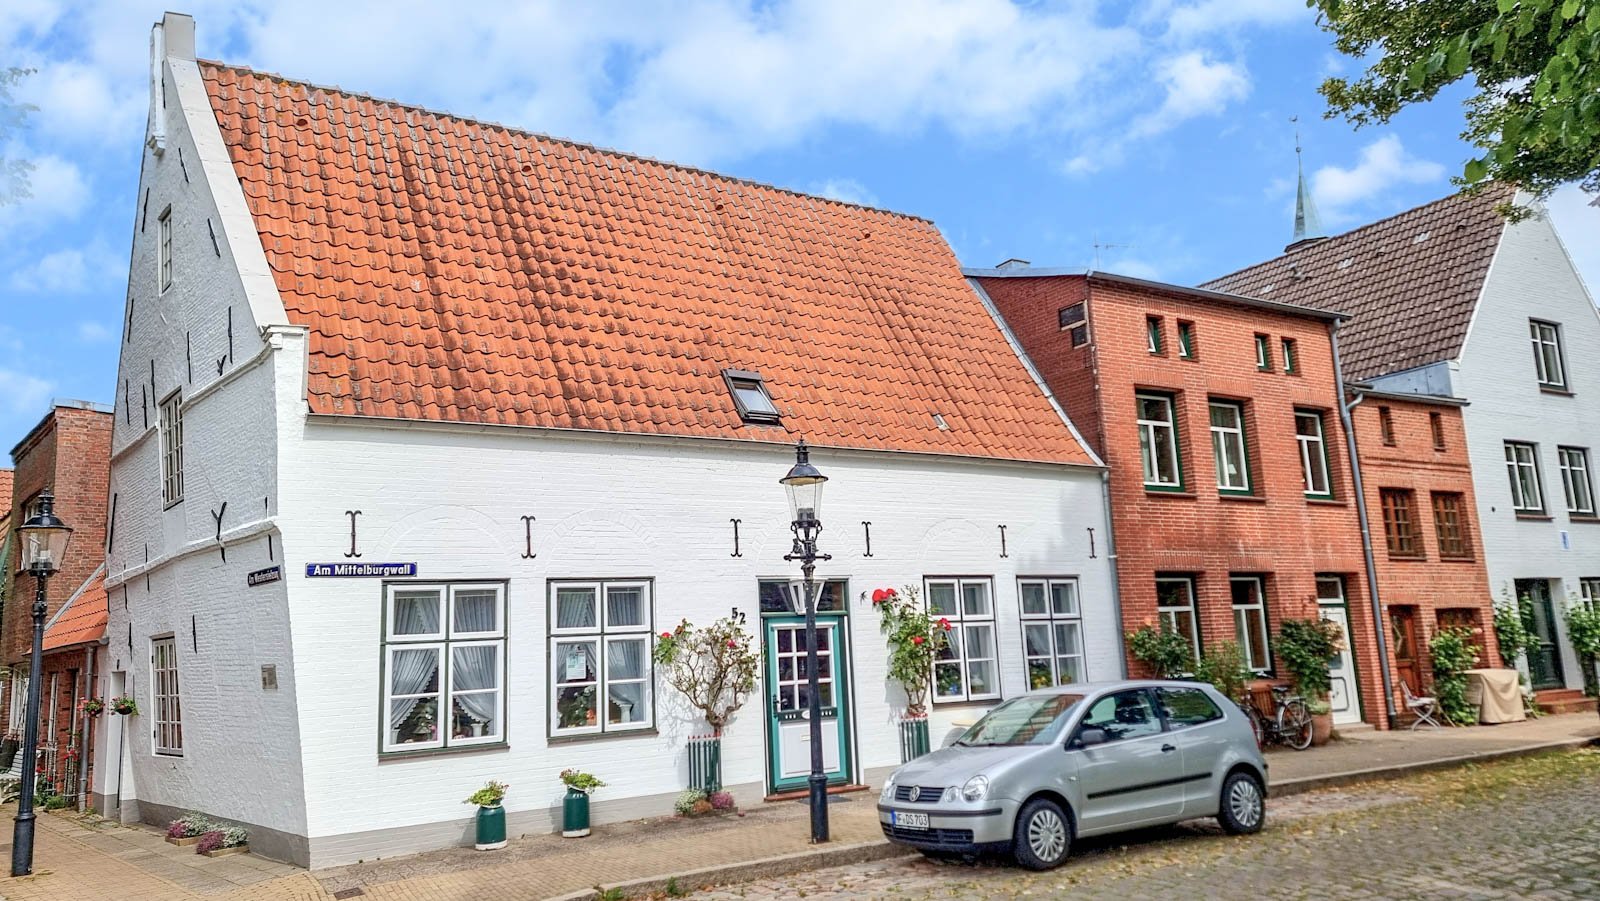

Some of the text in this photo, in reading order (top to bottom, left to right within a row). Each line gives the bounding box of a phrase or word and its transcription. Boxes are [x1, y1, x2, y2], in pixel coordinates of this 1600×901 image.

[313, 564, 411, 577] Am Mittelburgwall
[731, 607, 746, 625] 52
[914, 814, 928, 826] 703
